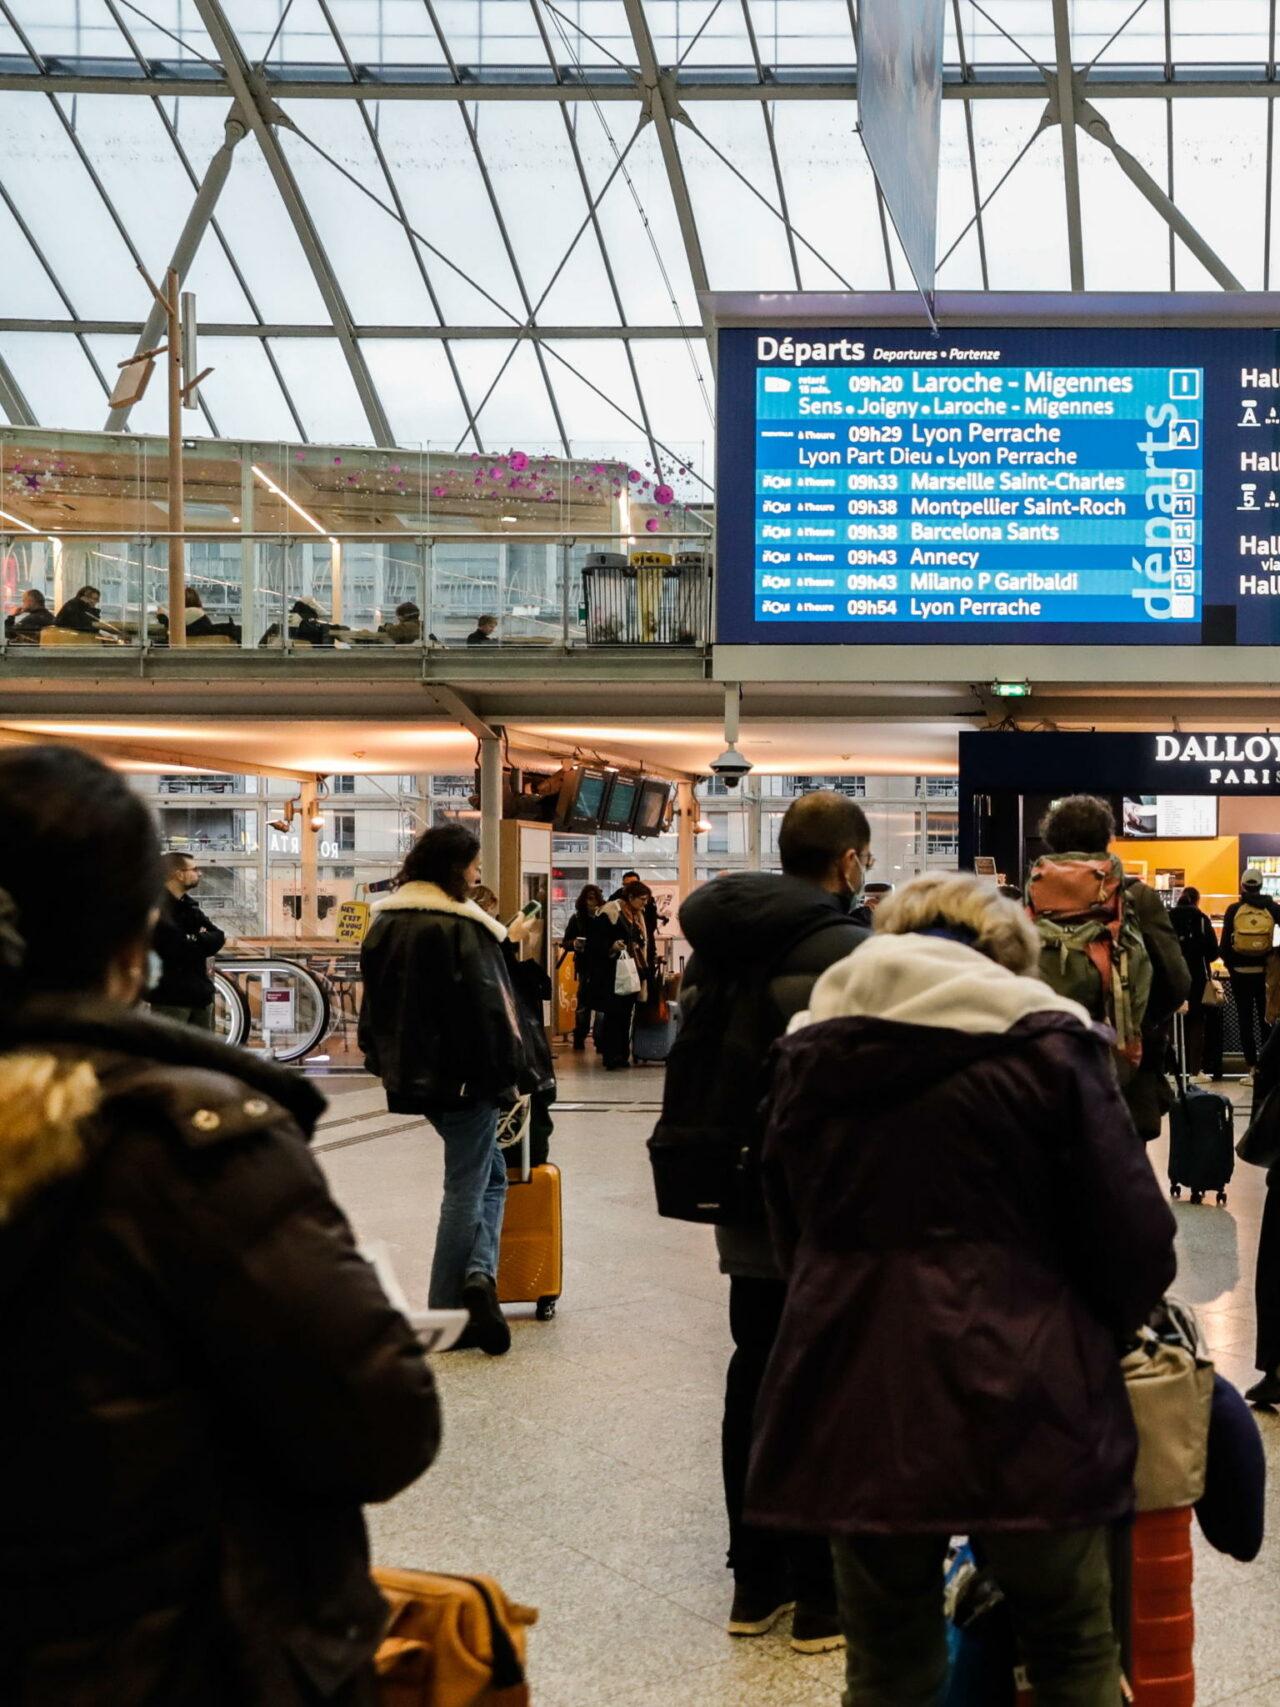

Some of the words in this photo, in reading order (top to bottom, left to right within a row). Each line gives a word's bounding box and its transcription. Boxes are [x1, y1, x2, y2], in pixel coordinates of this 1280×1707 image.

[758, 337, 865, 366] Départs
[873, 348, 937, 362] Departures
[950, 348, 1000, 360] Partenze
[849, 376, 902, 392] 09h20
[913, 372, 1002, 392] Laroche
[1025, 373, 1132, 398] Migennes
[800, 397, 842, 414] Sens
[858, 398, 918, 418] Joigny
[934, 398, 1006, 414] Laroche
[1026, 398, 1113, 418] Migennes
[1242, 408, 1257, 423] A
[849, 426, 902, 442] 09h29
[913, 424, 961, 446] Lyon
[970, 423, 1060, 442] Perrache
[1178, 426, 1191, 442] A
[800, 448, 840, 467] Lyon
[848, 448, 884, 464] Part
[891, 446, 931, 464] Dieu
[949, 448, 990, 468] Lyon
[998, 448, 1076, 464] Perrache
[848, 475, 898, 490] 09h33
[912, 473, 994, 490] Marseille
[1000, 472, 1125, 490] Saint-Charles
[848, 500, 897, 514] 09h38
[912, 498, 1018, 518] Montpellier
[1024, 498, 1125, 514] Saint-Roch
[1176, 500, 1190, 512] 11
[1244, 492, 1254, 507] 5
[848, 525, 898, 540] 09h38
[912, 522, 1002, 540] Barcelona
[1008, 522, 1059, 540] Sants
[1176, 525, 1190, 537] 11
[848, 550, 897, 564] 09h43
[910, 548, 978, 568] Annecy
[1176, 550, 1191, 562] 13
[1262, 558, 1280, 570] via
[848, 575, 897, 590] 09h43
[911, 573, 974, 590] Milano
[978, 572, 991, 590] P
[995, 572, 1078, 590] Garibaldi
[1176, 575, 1191, 587] 13
[848, 600, 897, 614] 09h54
[911, 598, 954, 618] Lyon
[960, 598, 1040, 615] Perrache
